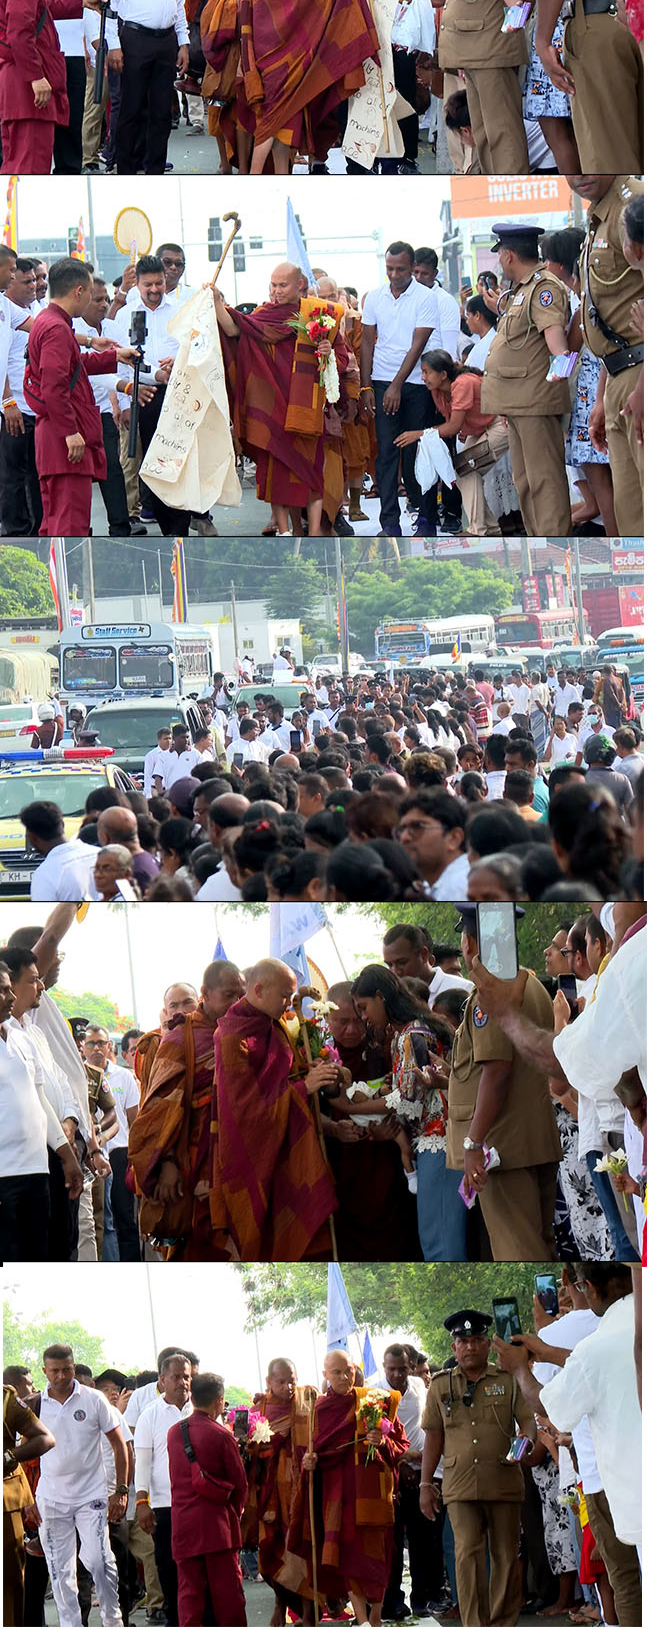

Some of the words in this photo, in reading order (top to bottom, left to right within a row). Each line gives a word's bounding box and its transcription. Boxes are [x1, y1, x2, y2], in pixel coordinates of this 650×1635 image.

[488, 180, 559, 203] INVERTER
[95, 626, 111, 635] Staff
[110, 626, 138, 635] Service
[8, 872, 20, 881] KH
